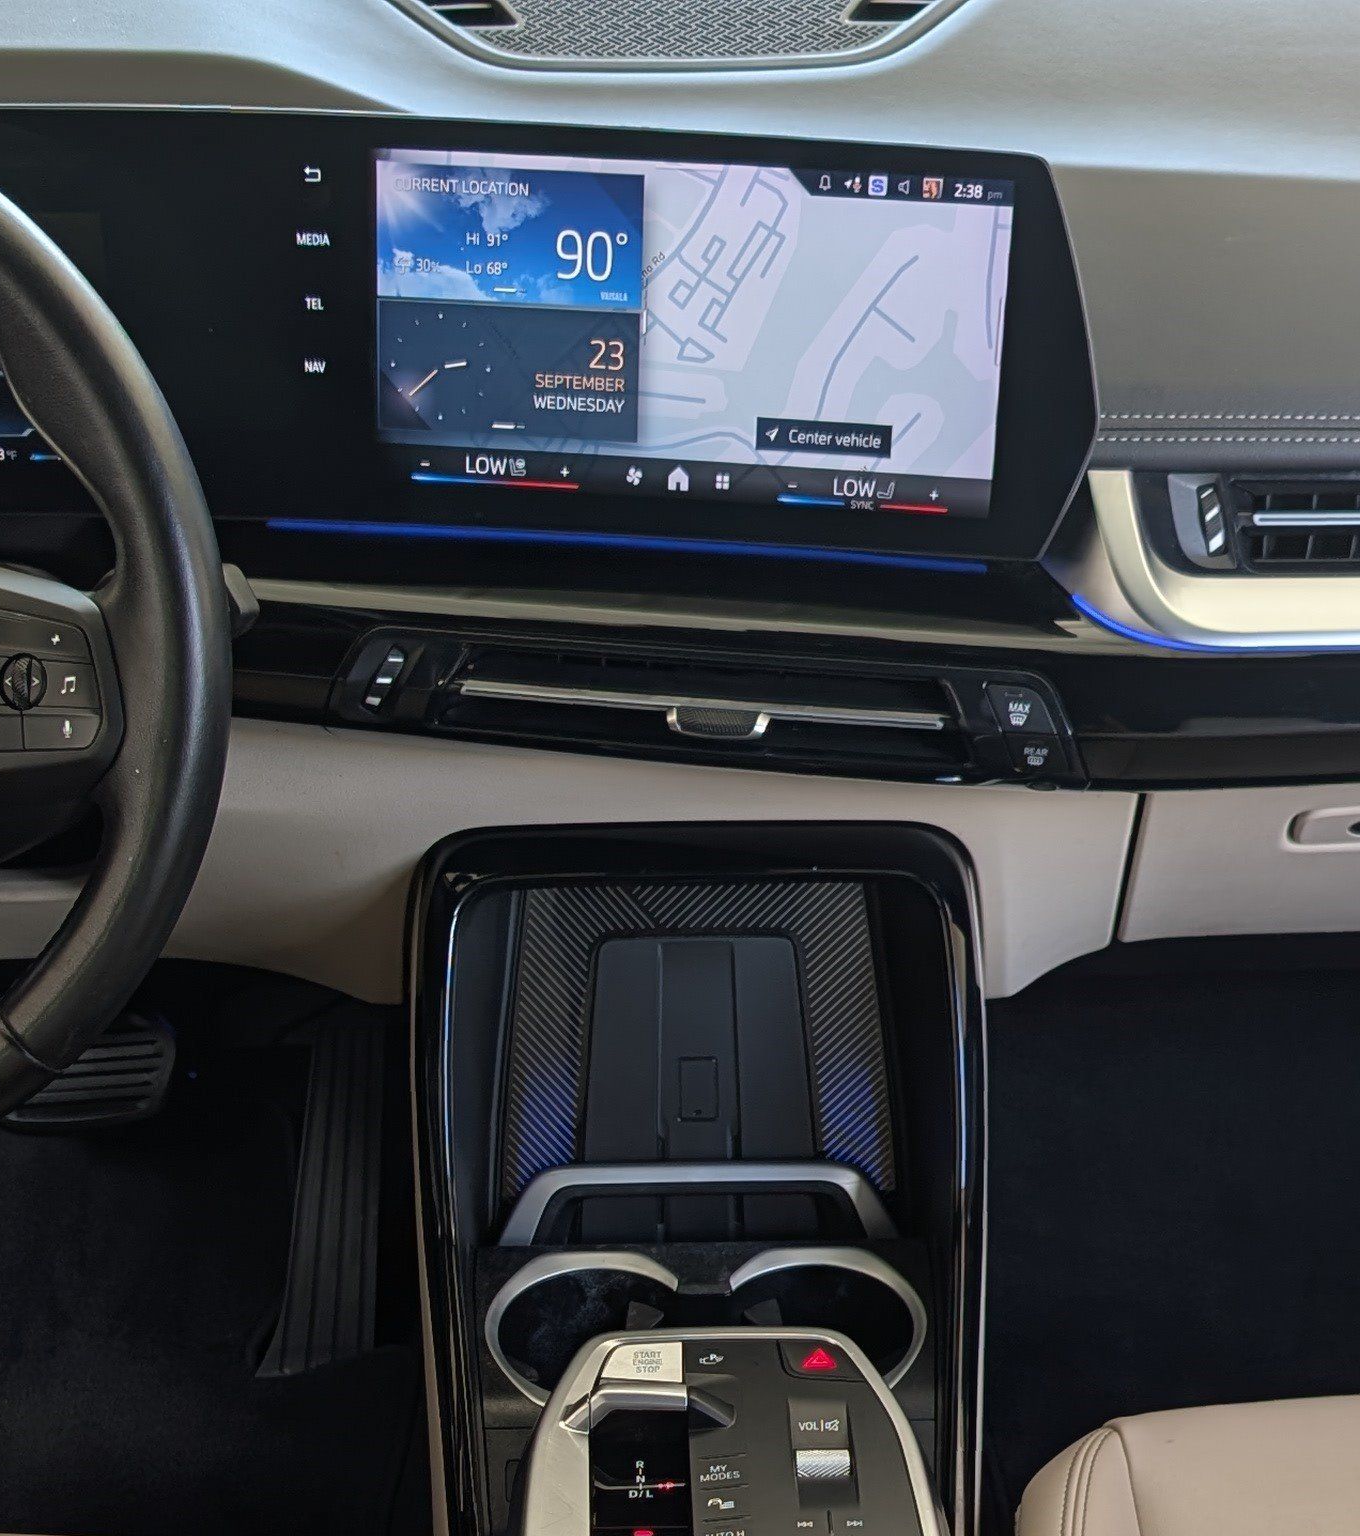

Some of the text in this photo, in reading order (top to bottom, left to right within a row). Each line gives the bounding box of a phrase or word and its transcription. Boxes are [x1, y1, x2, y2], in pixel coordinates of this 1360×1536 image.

[394, 177, 530, 196] CURRENT LOCATION
[953, 183, 1002, 201] 2:38 pm
[296, 232, 330, 246] MEDIA
[466, 232, 509, 247] Hi 91°
[555, 229, 629, 282] 90°
[466, 261, 508, 276] Lo 68°
[305, 297, 324, 310] TEL
[589, 338, 625, 371] 23
[304, 358, 326, 373] NAV
[534, 373, 625, 392] SEPTEMBER
[533, 394, 625, 414] WEDNESDAY
[789, 429, 881, 449] Center vehicle
[465, 454, 507, 476] LOW
[833, 477, 876, 498] LOW
[850, 500, 874, 511] SYNC
[1008, 702, 1030, 713] MAX
[1024, 747, 1048, 756] REAR
[633, 1350, 662, 1359] START
[635, 1365, 660, 1374] STOP
[798, 1421, 819, 1431] VOL
[635, 1460, 644, 1469] R
[709, 1464, 728, 1473] MY
[635, 1474, 645, 1483] N
[700, 1470, 740, 1482] MODES
